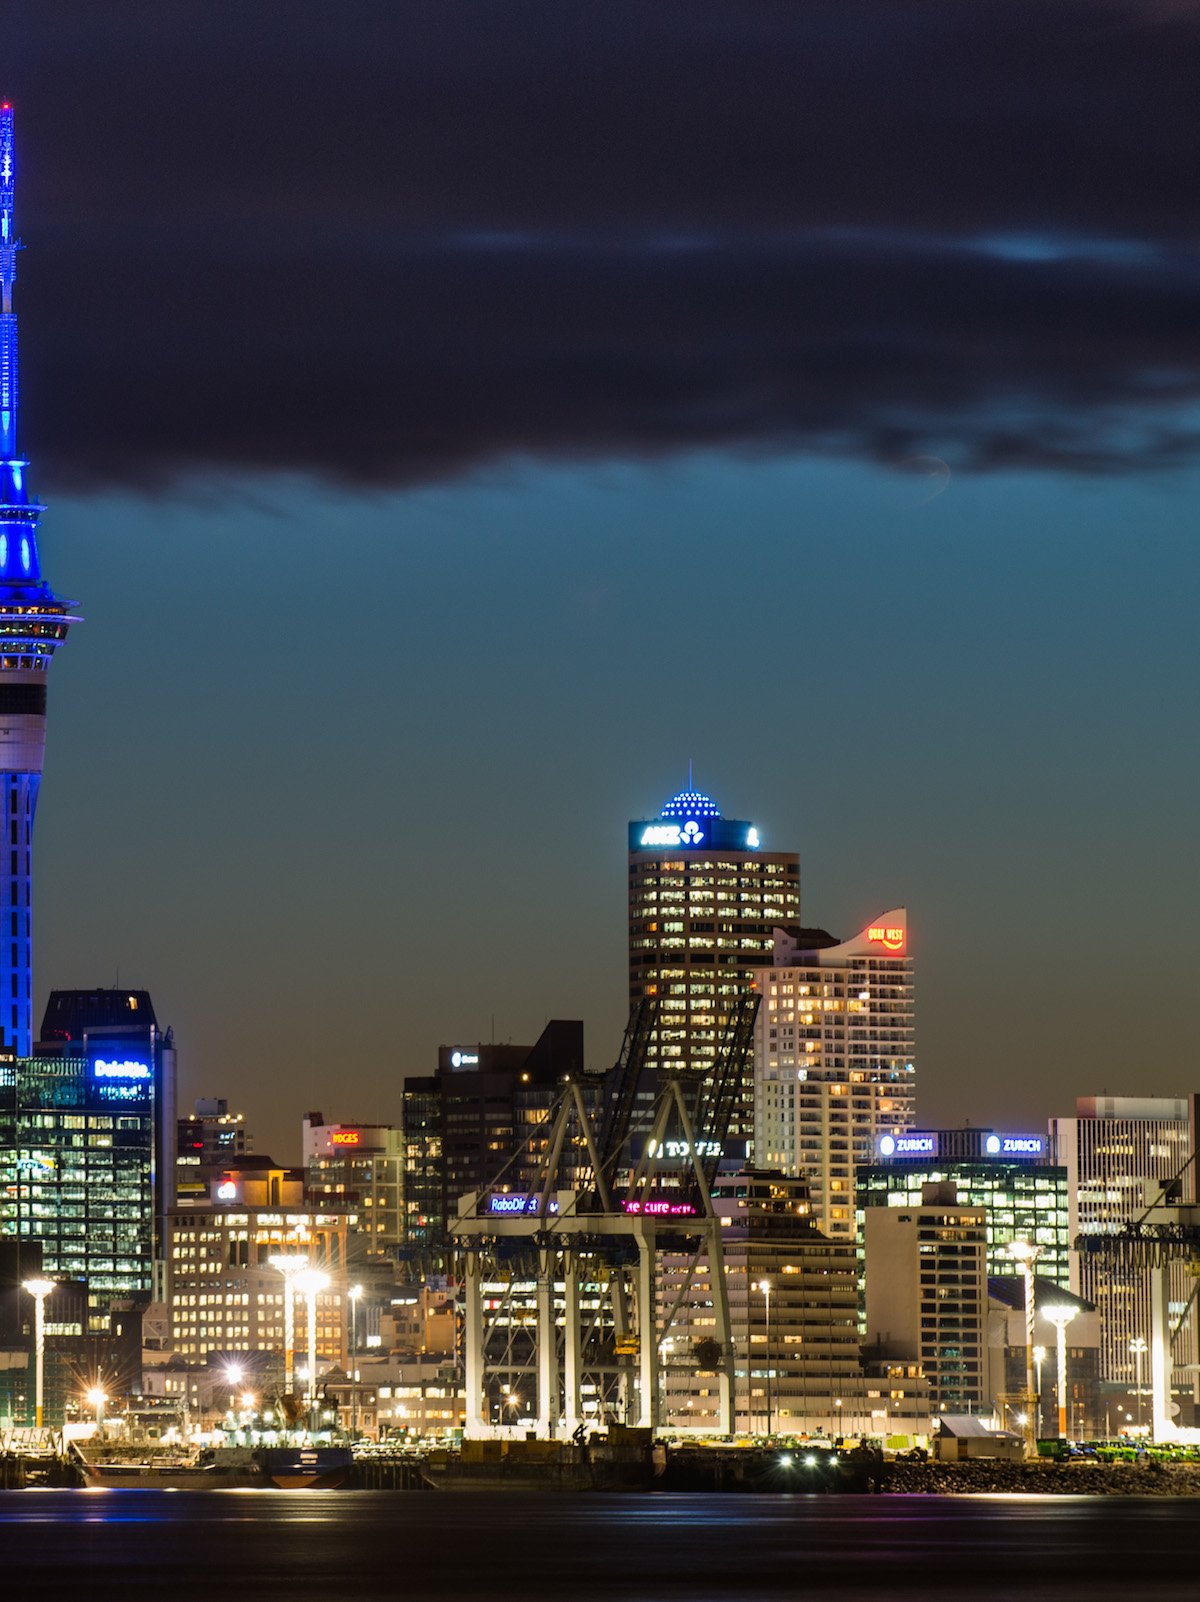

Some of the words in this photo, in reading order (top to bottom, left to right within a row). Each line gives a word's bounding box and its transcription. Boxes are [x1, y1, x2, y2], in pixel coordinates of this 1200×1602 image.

[896, 1138, 933, 1152] ZURICH
[1003, 1139, 1041, 1152] ZURICH
[491, 1197, 538, 1212] RaboDirct
